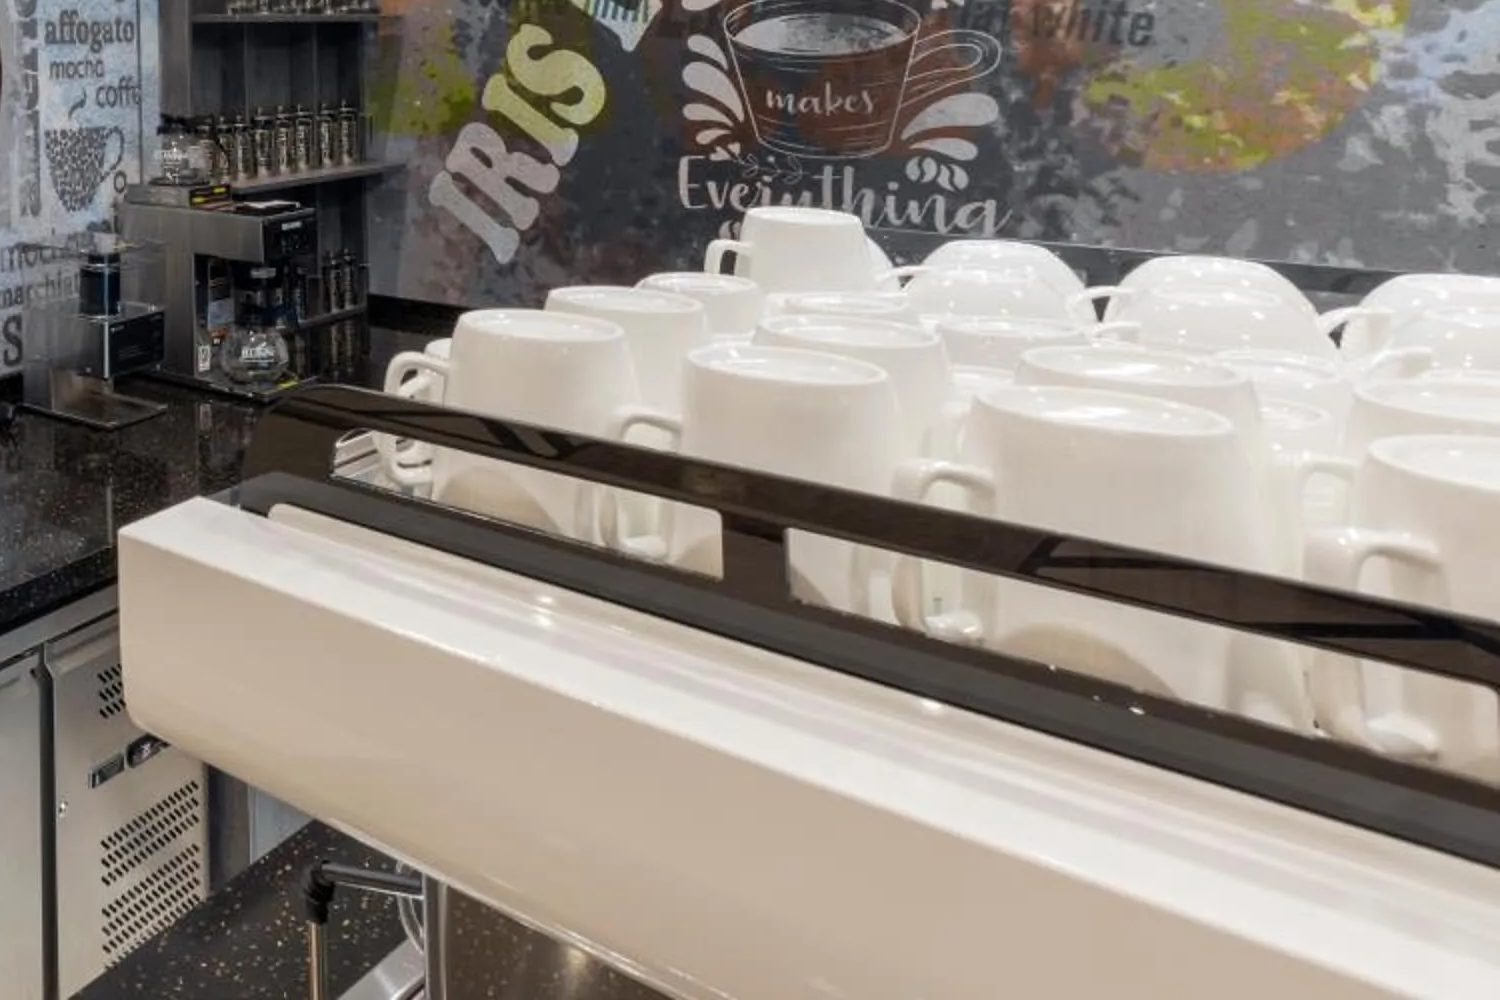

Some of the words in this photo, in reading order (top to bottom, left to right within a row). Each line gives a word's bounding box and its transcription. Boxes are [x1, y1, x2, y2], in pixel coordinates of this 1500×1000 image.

[43, 9, 136, 53] affogato
[49, 54, 105, 81] mocha
[764, 81, 876, 118] makes
[428, 23, 608, 265] IRIS
